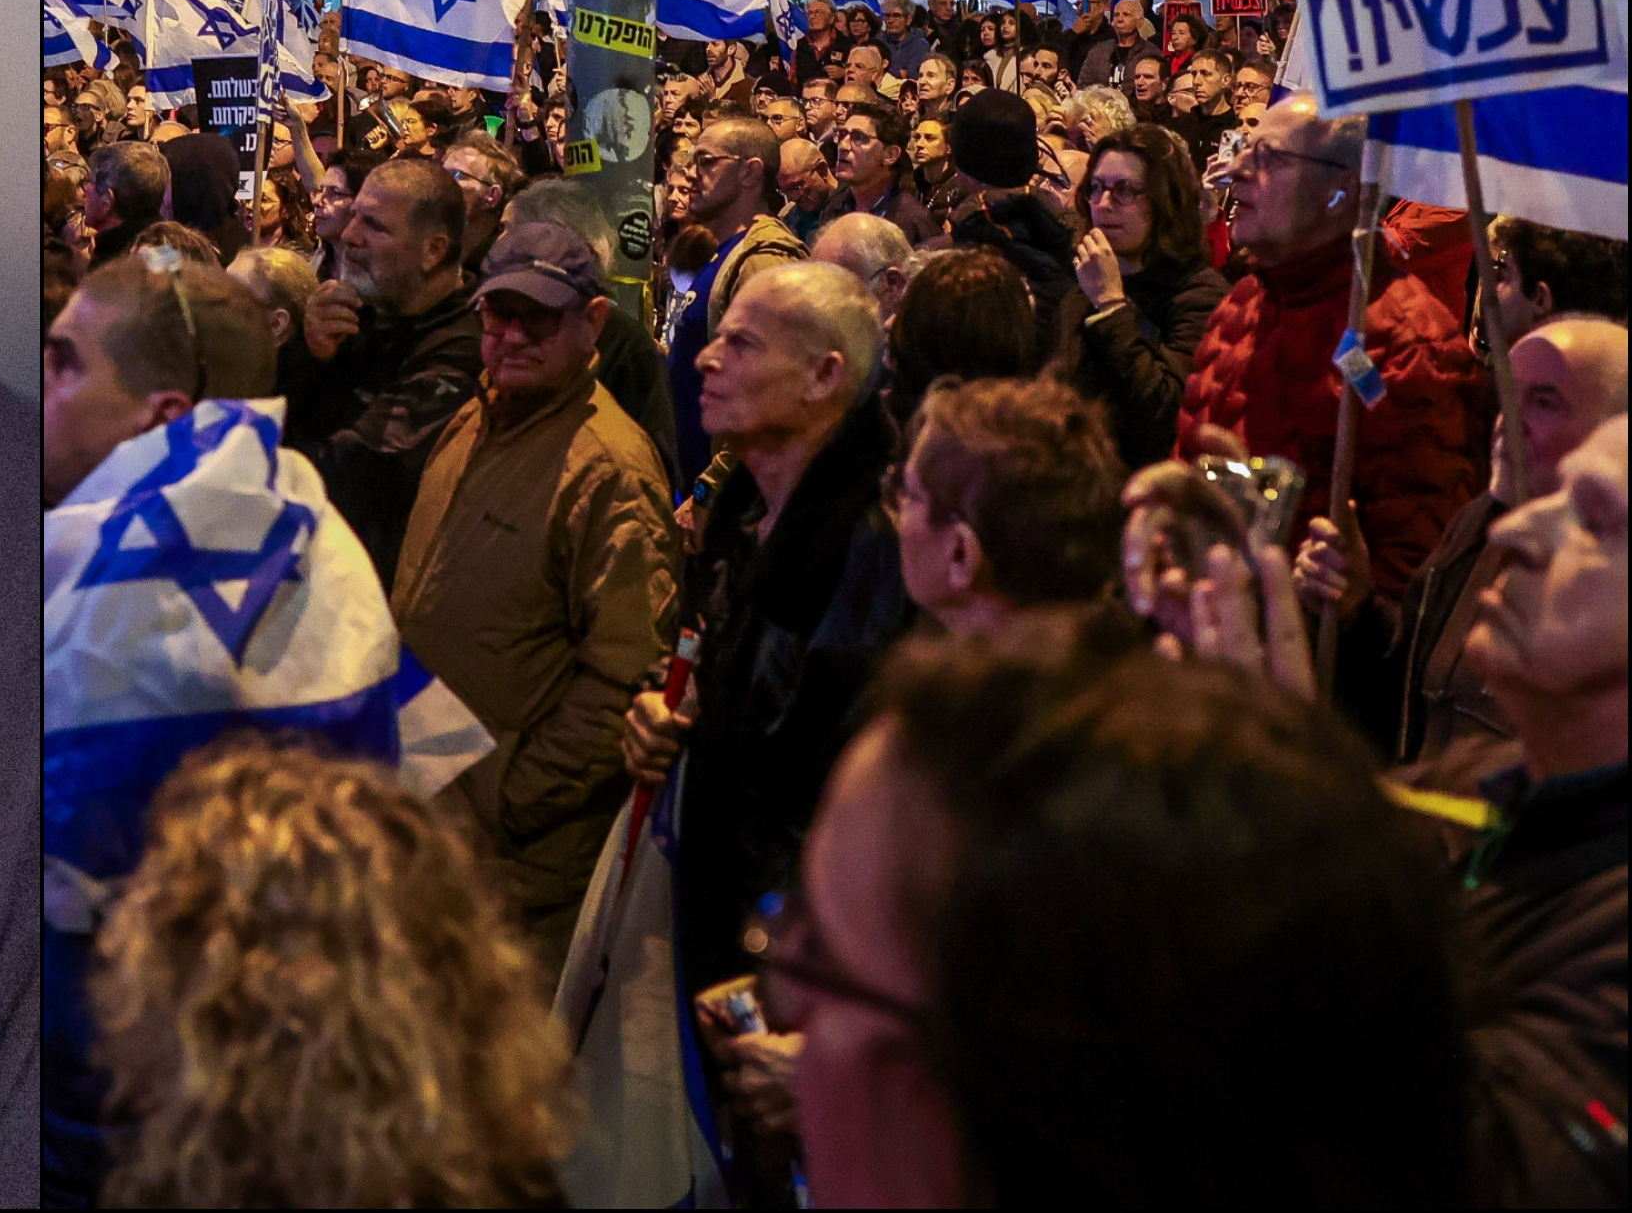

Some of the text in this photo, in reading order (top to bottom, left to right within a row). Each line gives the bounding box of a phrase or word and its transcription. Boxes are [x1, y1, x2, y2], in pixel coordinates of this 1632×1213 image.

[578, 11, 653, 50] הופקרנו
[207, 77, 258, 98] כשלתם.
[208, 106, 256, 127] פקרתם.
